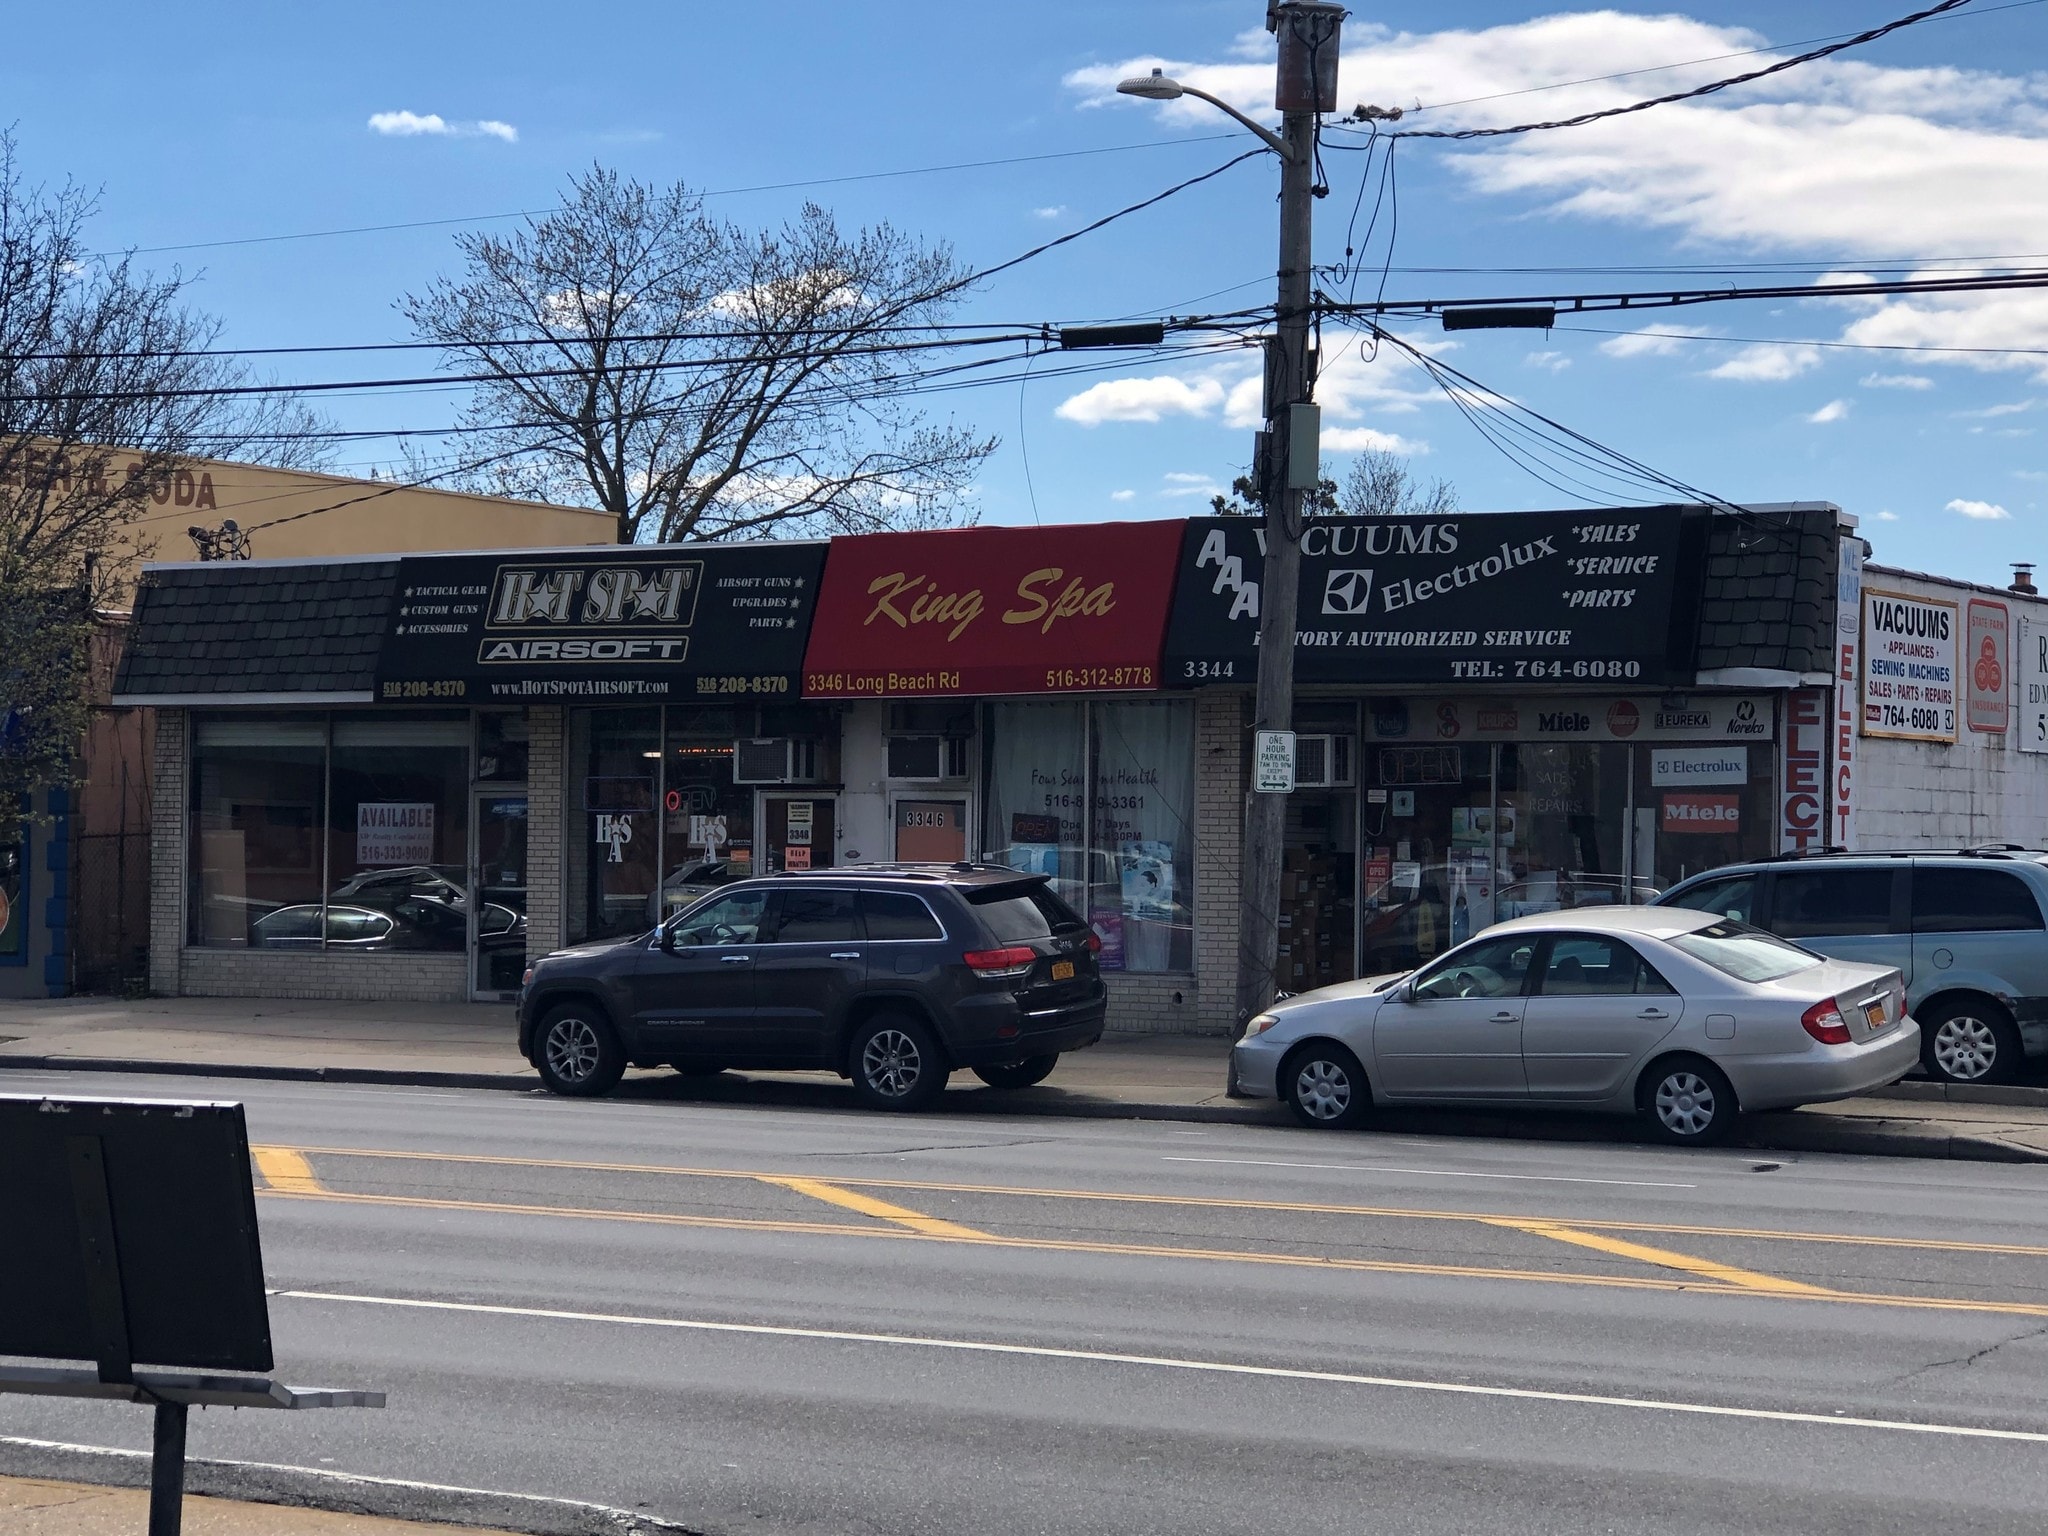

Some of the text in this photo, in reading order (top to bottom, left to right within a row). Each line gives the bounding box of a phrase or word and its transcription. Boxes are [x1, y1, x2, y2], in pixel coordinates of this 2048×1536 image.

[1252, 523, 1459, 558] VCUUMS
[1381, 534, 1559, 613] Electrolux
[416, 585, 487, 596] TACTICAL GEAR
[716, 577, 791, 588] AIRSOFT GUNS
[411, 604, 478, 615] CUSTOM GUNS
[732, 598, 787, 608] UPGRADES
[863, 567, 1117, 642] King Spa
[407, 624, 469, 634] ACCESSORIES
[749, 617, 783, 628] PARTS
[1873, 600, 1950, 641] VACUUMS
[1346, 631, 1478, 646] AUTHORIZED
[1483, 630, 1572, 646] SERVICE
[485, 640, 682, 660] AIRSOFT
[1888, 641, 1935, 659] APPLIANCES
[1046, 666, 1152, 688] 516-312-8778
[1183, 661, 1235, 678] 3344
[1451, 660, 1641, 678] TEL: 764-6080
[1872, 659, 1950, 682] SEWING MACHINES
[383, 680, 466, 697] 516 208-8370
[696, 676, 788, 693] 516 208-8370
[808, 671, 960, 694] 3346 Long Beach Rd
[1869, 680, 1952, 705] SALES PARTS REPAIRS
[1538, 712, 1591, 732] Miele
[1665, 714, 1709, 726] EUREKA
[1726, 719, 1765, 734] Norelco
[1883, 705, 1939, 731] 764-6080
[1266, 745, 1286, 753] HOUR
[1268, 736, 1283, 745] ONE
[1261, 753, 1290, 761] PARKING
[1673, 759, 1742, 774] Electrolux
[1031, 769, 1056, 785] Four
[1118, 768, 1159, 786] Health
[1045, 794, 1145, 809] 516-89-3361
[1529, 798, 1583, 812] REPAIRS
[360, 808, 433, 828] AVAILABLE
[907, 812, 944, 828] 3346
[1665, 804, 1739, 821] Miele
[1106, 820, 1131, 832] Days
